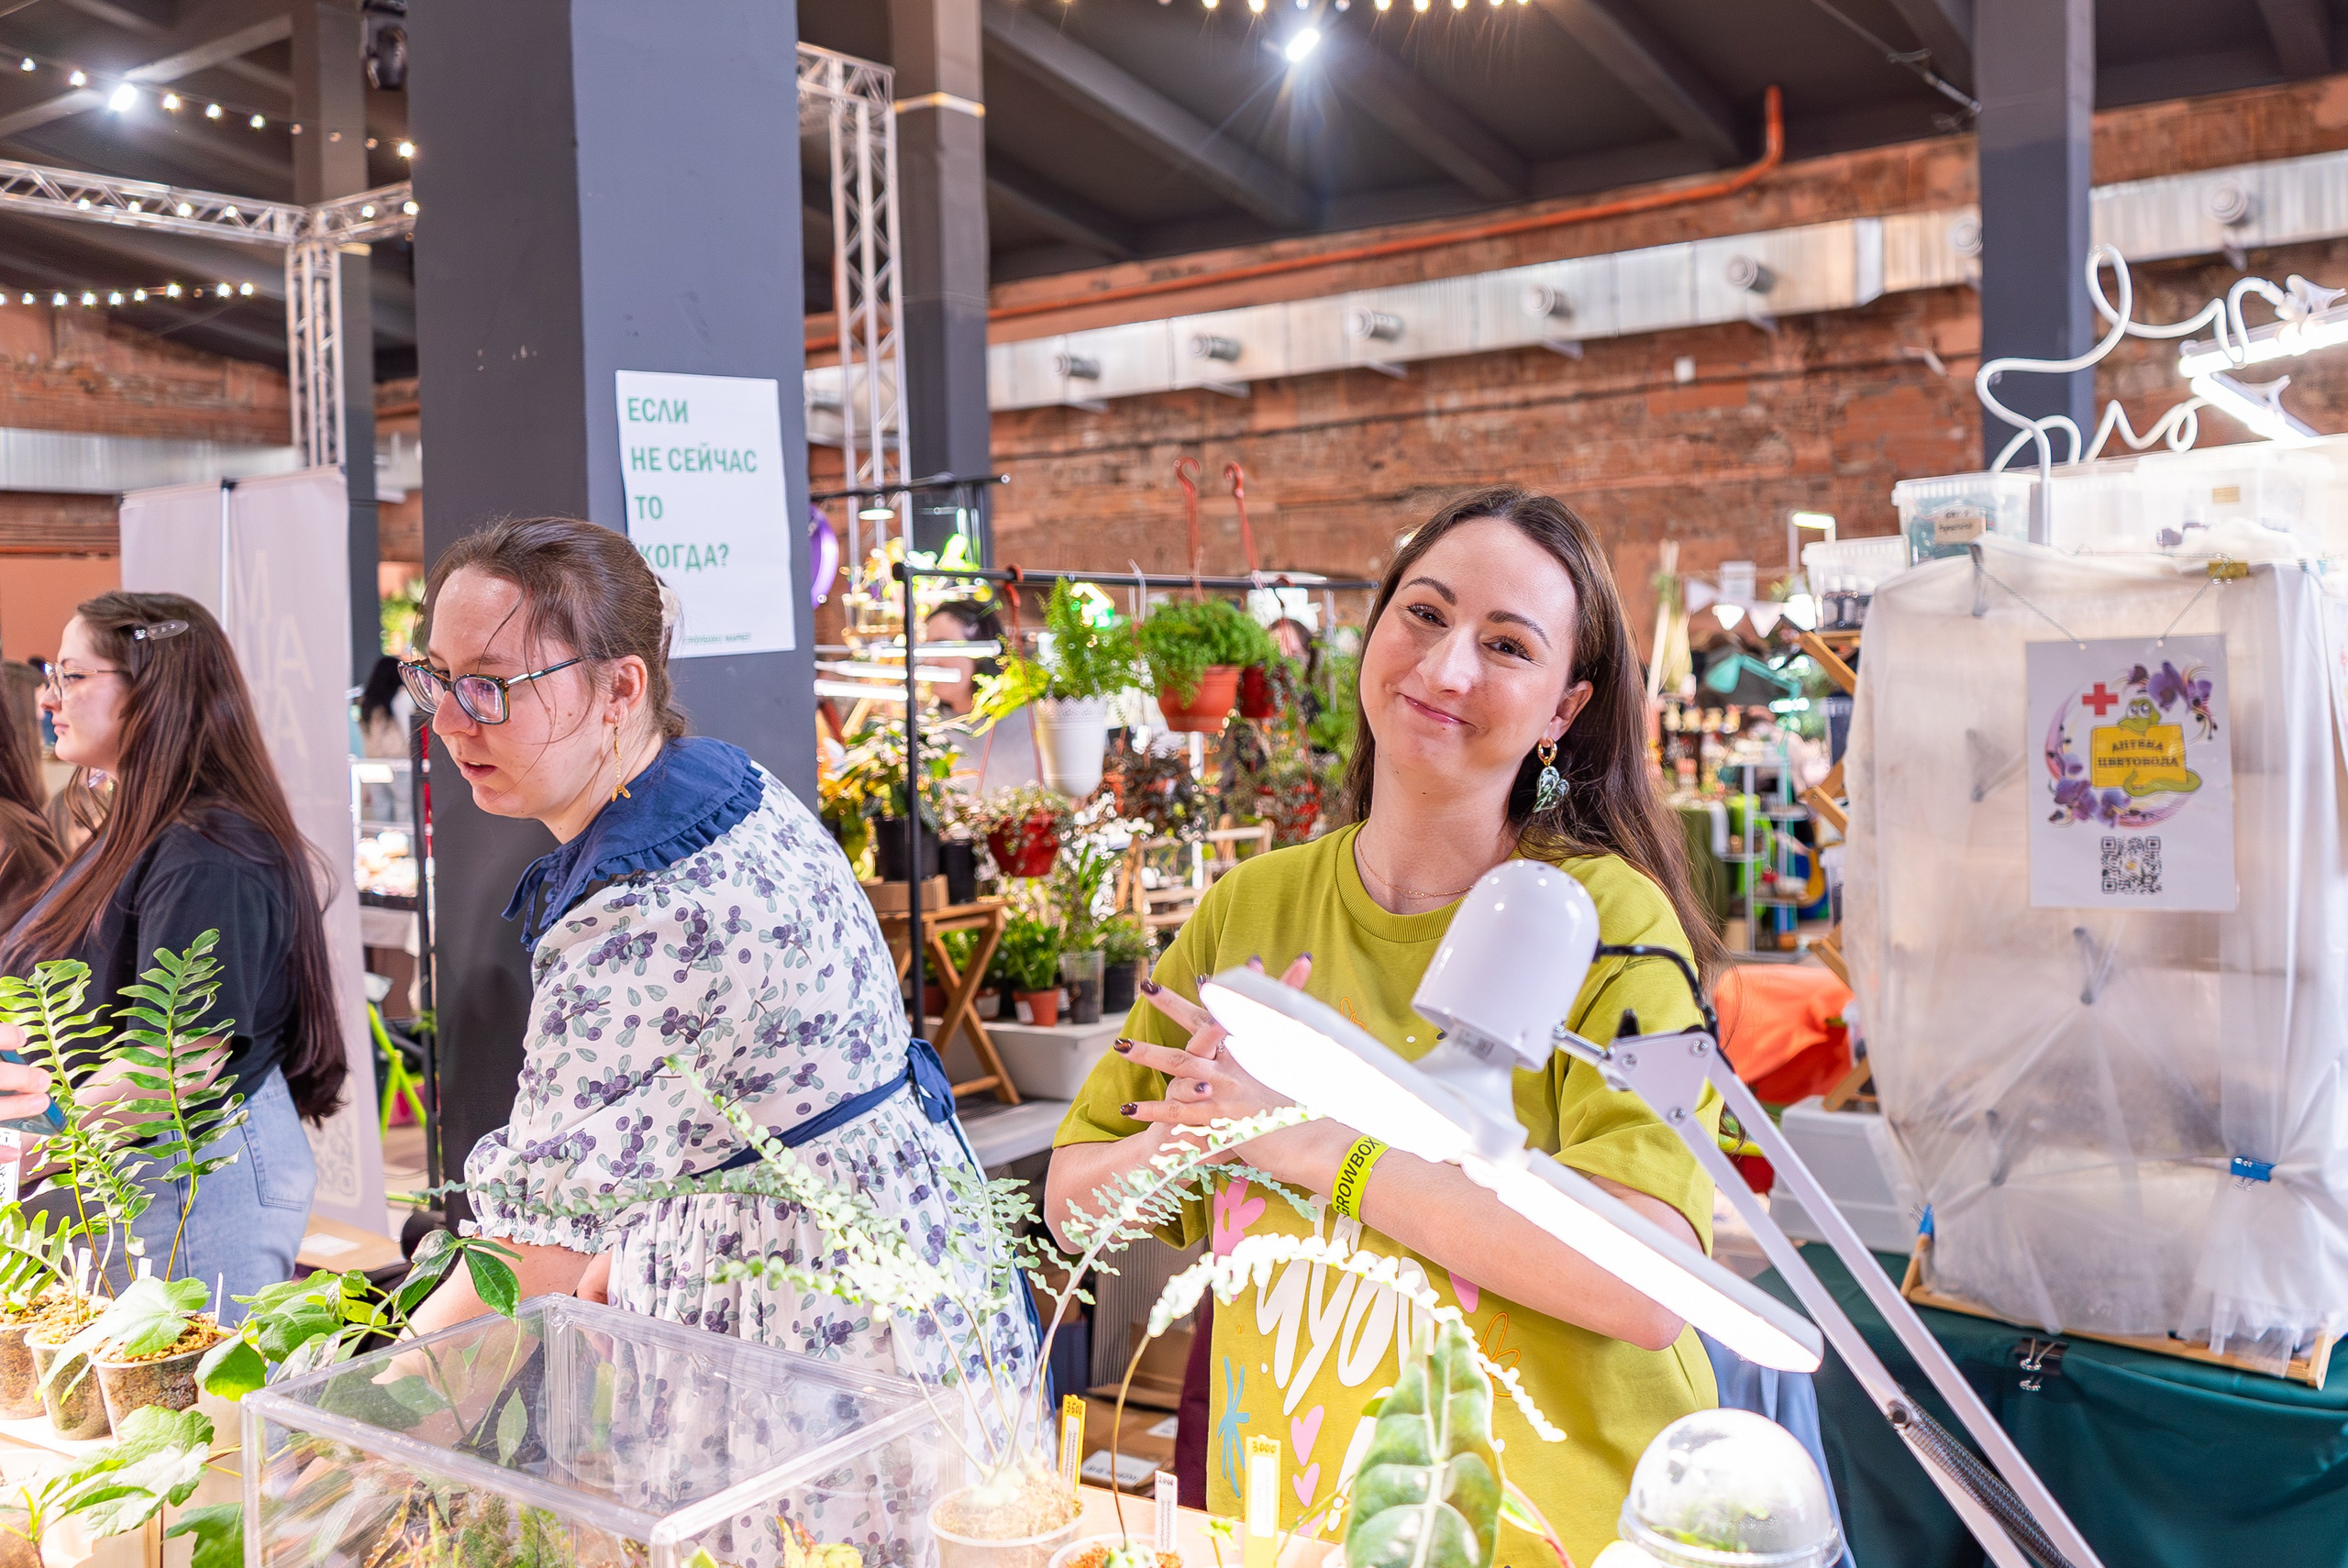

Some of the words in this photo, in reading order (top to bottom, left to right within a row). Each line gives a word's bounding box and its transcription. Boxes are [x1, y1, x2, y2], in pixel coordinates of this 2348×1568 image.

[627, 397, 689, 424] ЕСЛИ
[630, 446, 663, 472] НЕ
[668, 440, 759, 473] СЕЙЧАС
[635, 495, 664, 520] ТО
[2111, 738, 2165, 753] АПТЕКА
[2097, 756, 2180, 768] ЦВЕТОВОДА
[1336, 1137, 1380, 1220] GROWBOX
[1252, 1441, 1277, 1454] 3000
